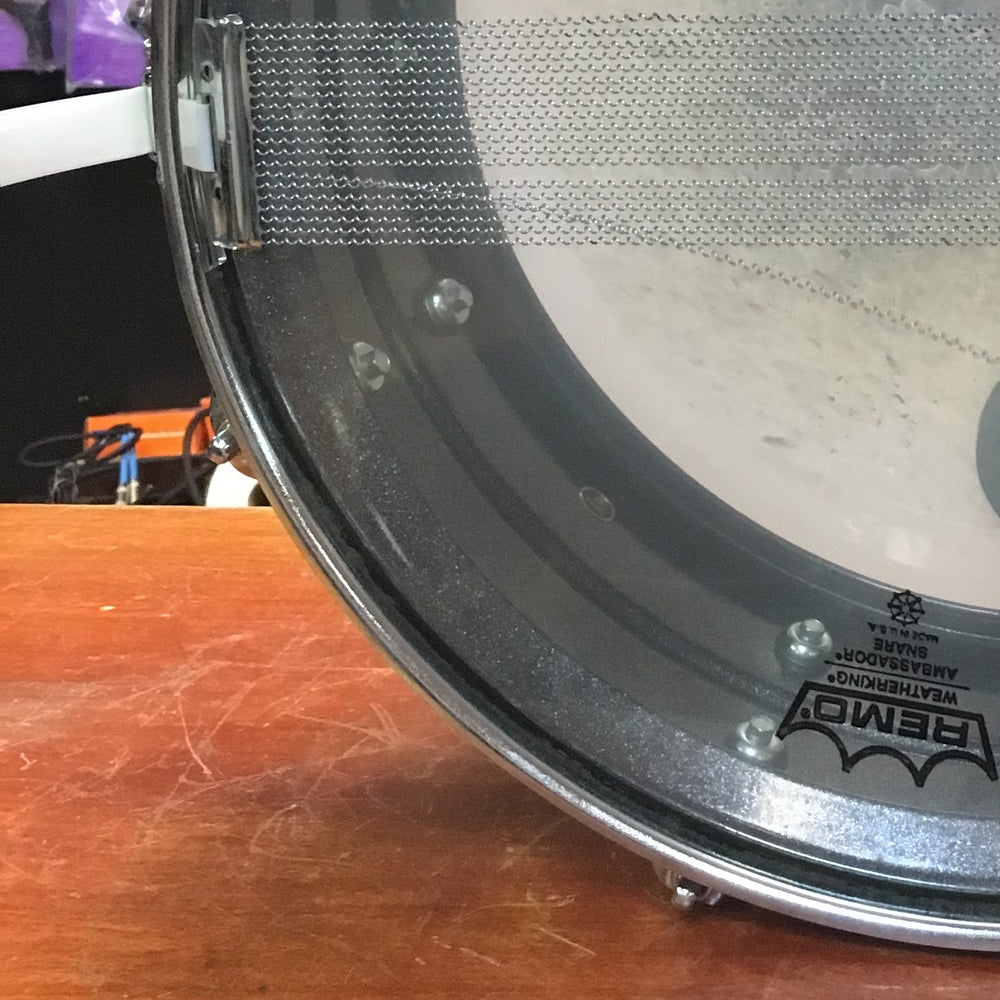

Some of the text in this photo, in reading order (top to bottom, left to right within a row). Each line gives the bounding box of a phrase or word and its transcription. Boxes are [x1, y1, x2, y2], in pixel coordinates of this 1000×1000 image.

[843, 647, 959, 681] AMBASSADOR
[873, 637, 928, 659] SNARE
[835, 670, 958, 706] WEATHERKING
[812, 694, 969, 748] REMO
